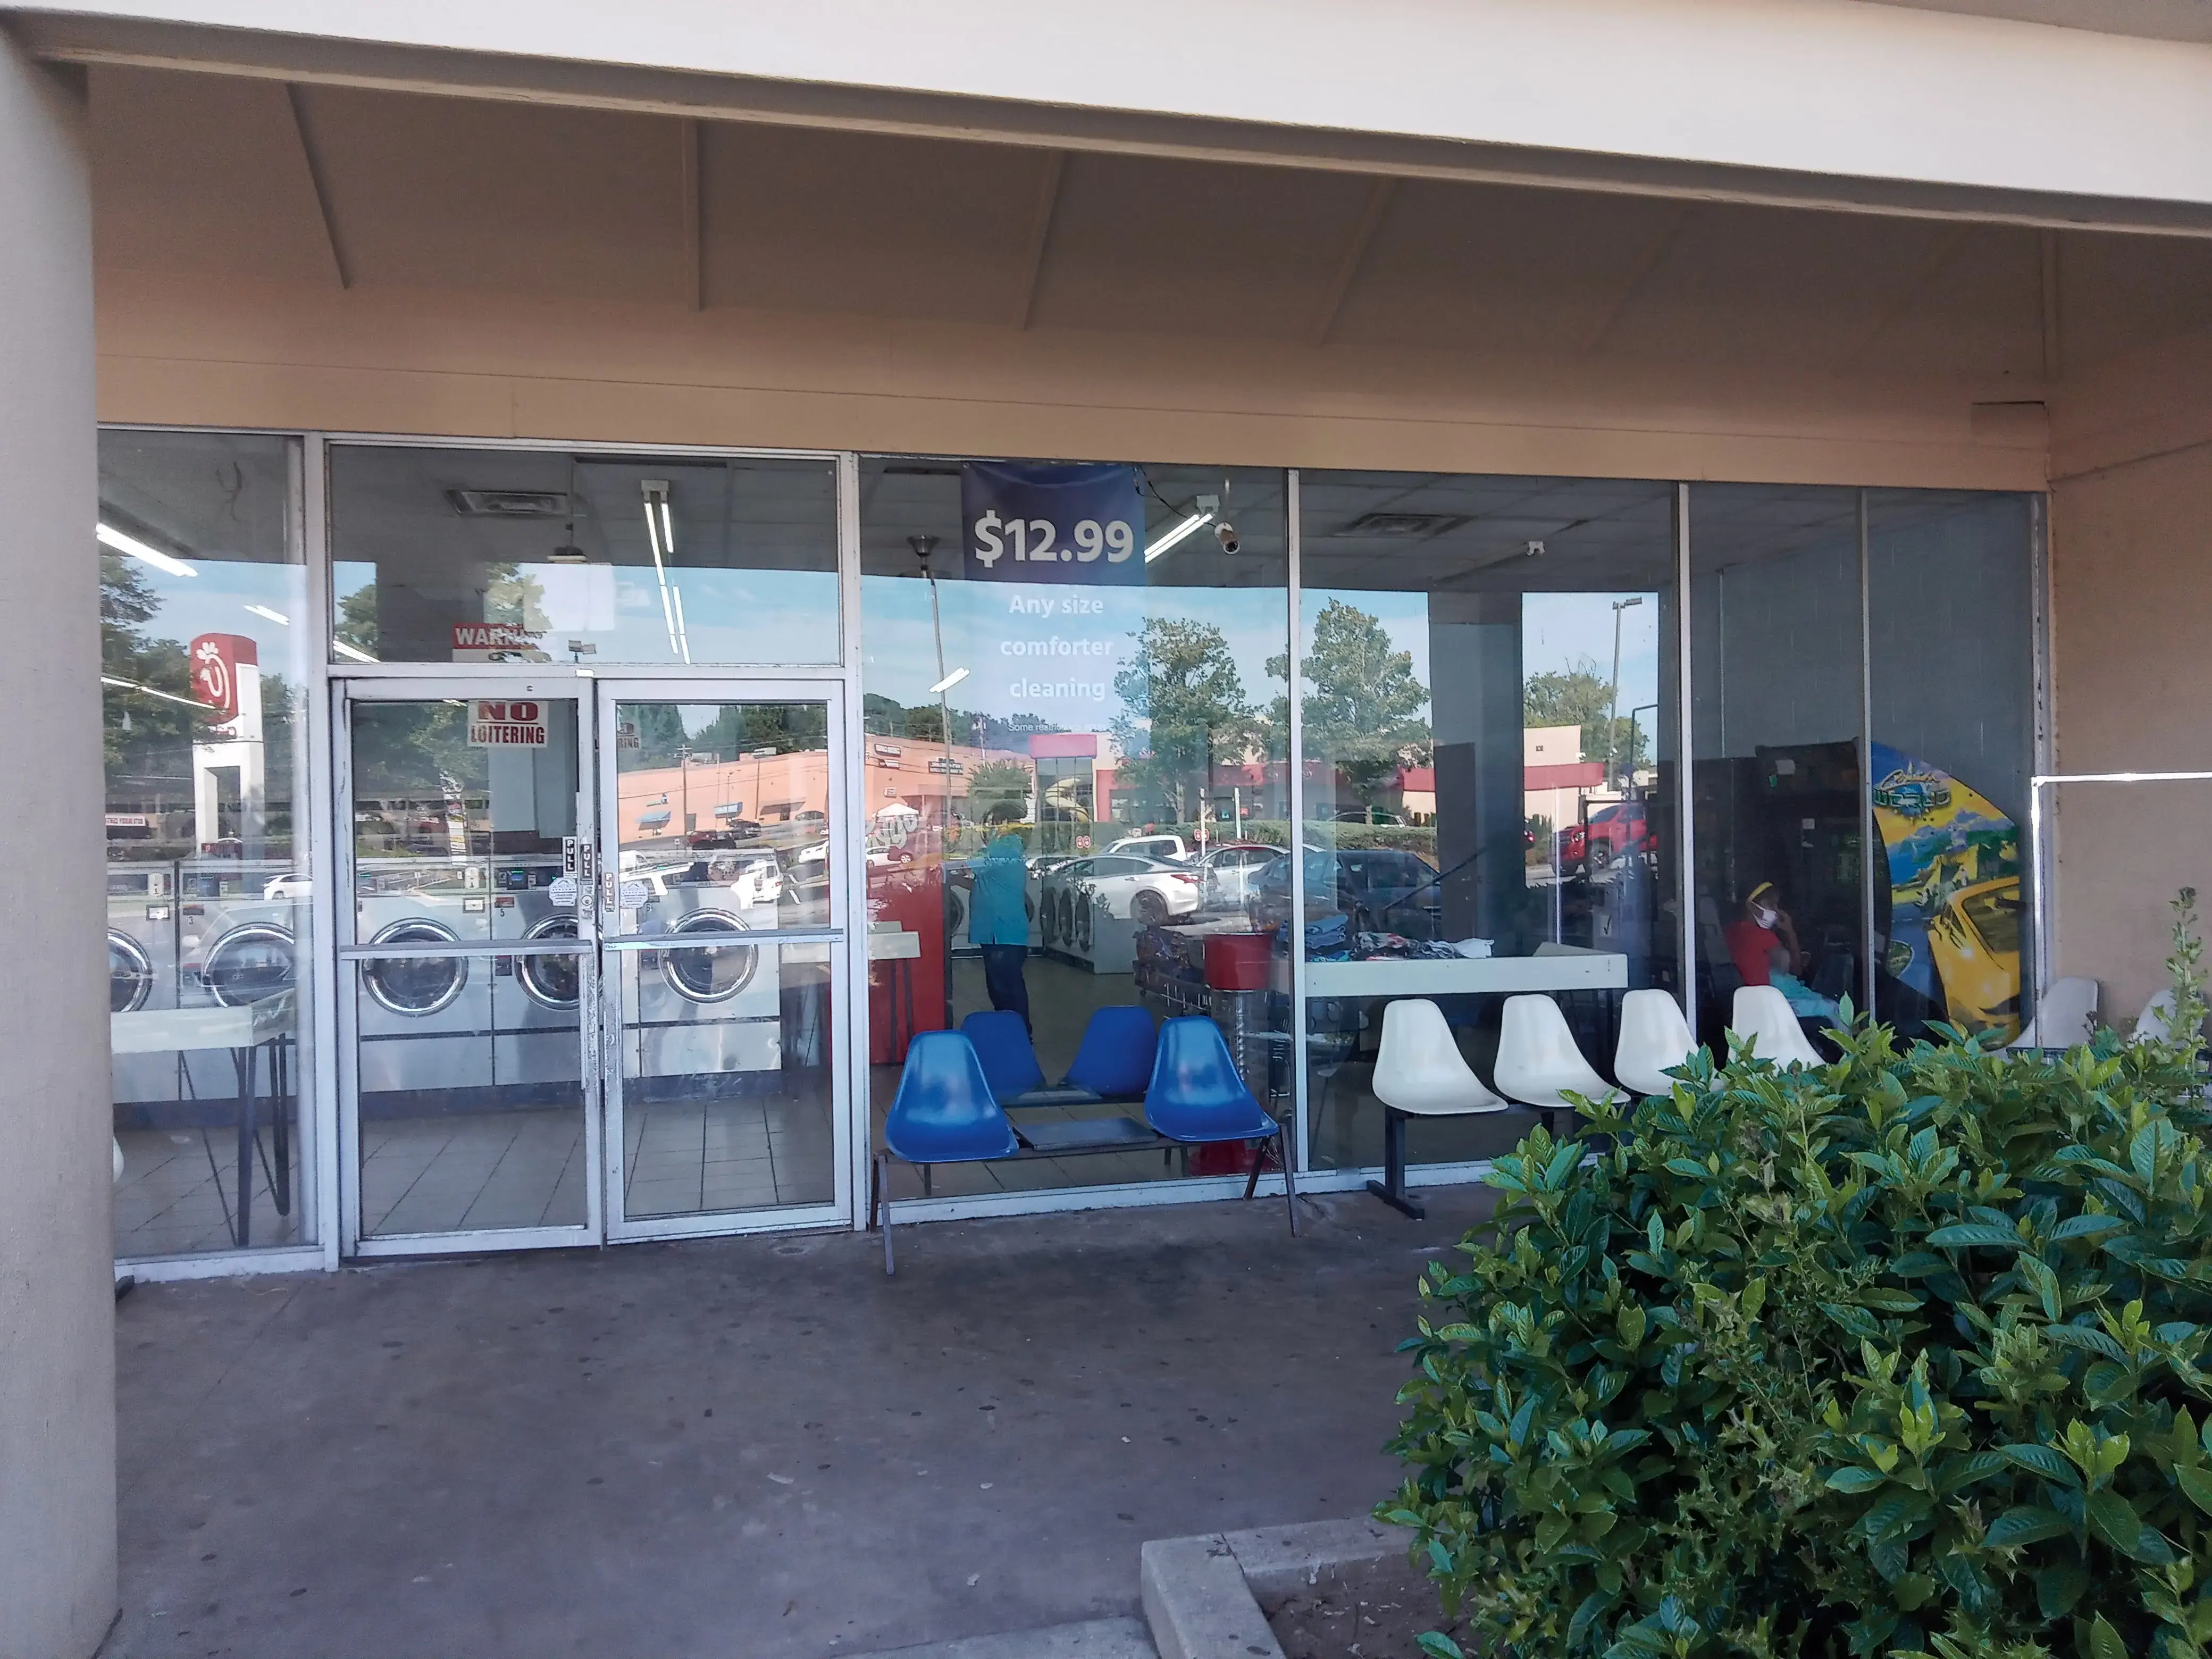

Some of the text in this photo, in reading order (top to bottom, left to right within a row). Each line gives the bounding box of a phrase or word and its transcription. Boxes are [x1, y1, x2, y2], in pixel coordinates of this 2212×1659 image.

[974, 510, 1134, 568] $12.99
[1009, 594, 1103, 618] Any size
[1000, 636, 1113, 656] comforter
[1009, 678, 1105, 701] cleaning
[479, 701, 538, 721] NO
[471, 725, 545, 744] LOITERING
[1008, 723, 1035, 732] Some
[500, 908, 505, 917] 5
